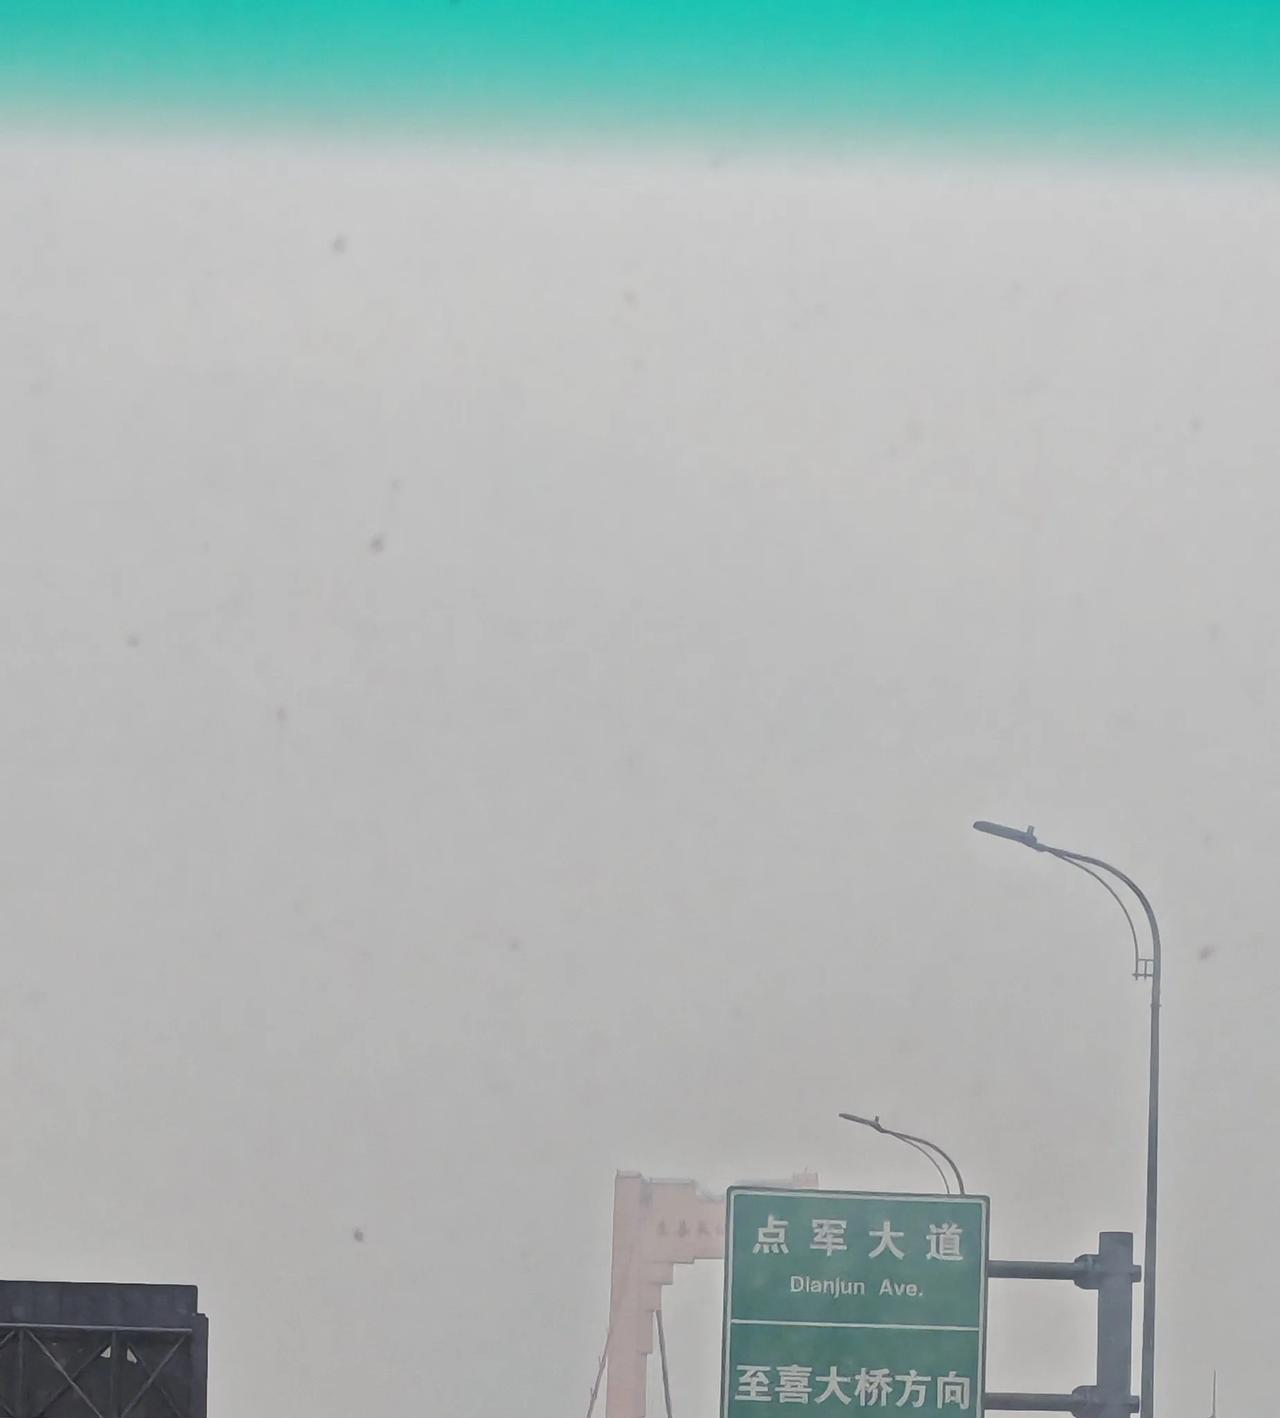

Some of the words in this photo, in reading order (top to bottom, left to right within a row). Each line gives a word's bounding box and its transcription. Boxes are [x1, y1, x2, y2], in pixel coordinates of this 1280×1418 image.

[752, 1214, 964, 1262] 点军大道
[790, 1275, 865, 1298] Dianjun
[879, 1279, 924, 1297] Ave.
[734, 1364, 971, 1410] 至喜大桥方向
